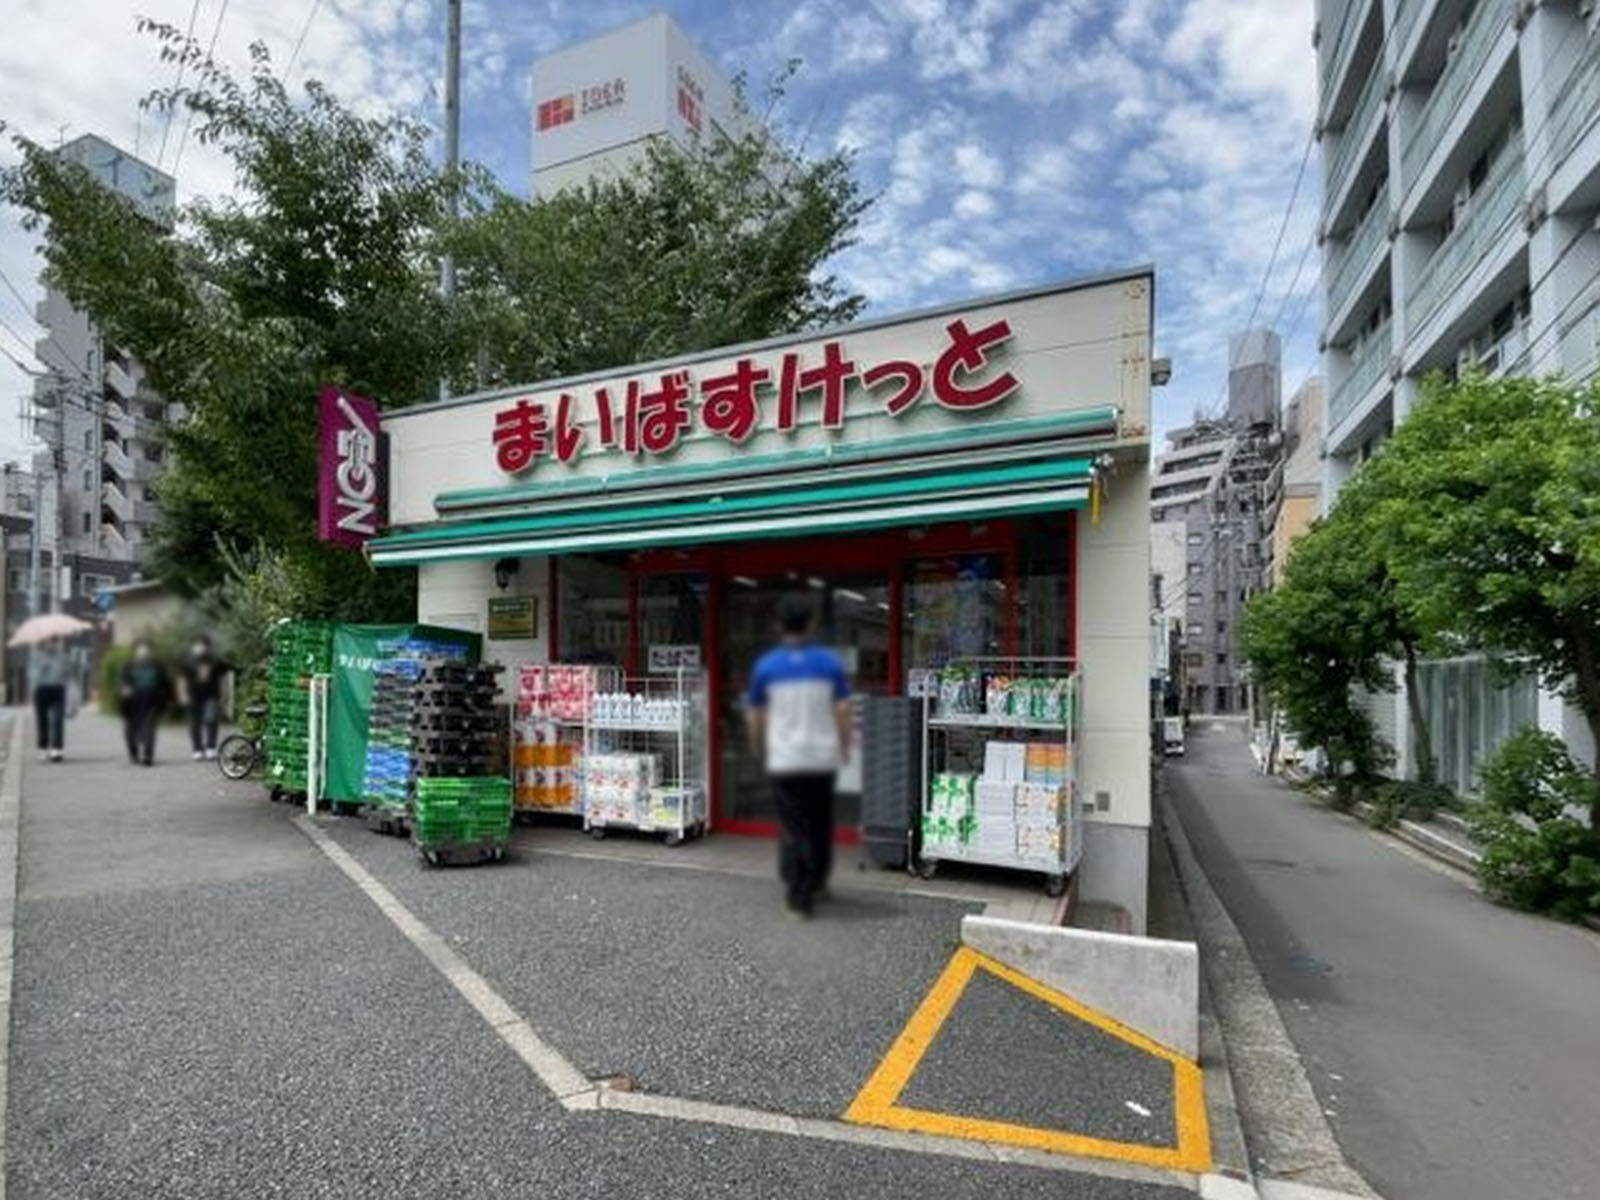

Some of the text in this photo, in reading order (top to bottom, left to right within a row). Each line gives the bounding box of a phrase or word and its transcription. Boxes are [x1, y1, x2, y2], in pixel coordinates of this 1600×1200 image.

[492, 318, 1020, 476] まいばすけっと
